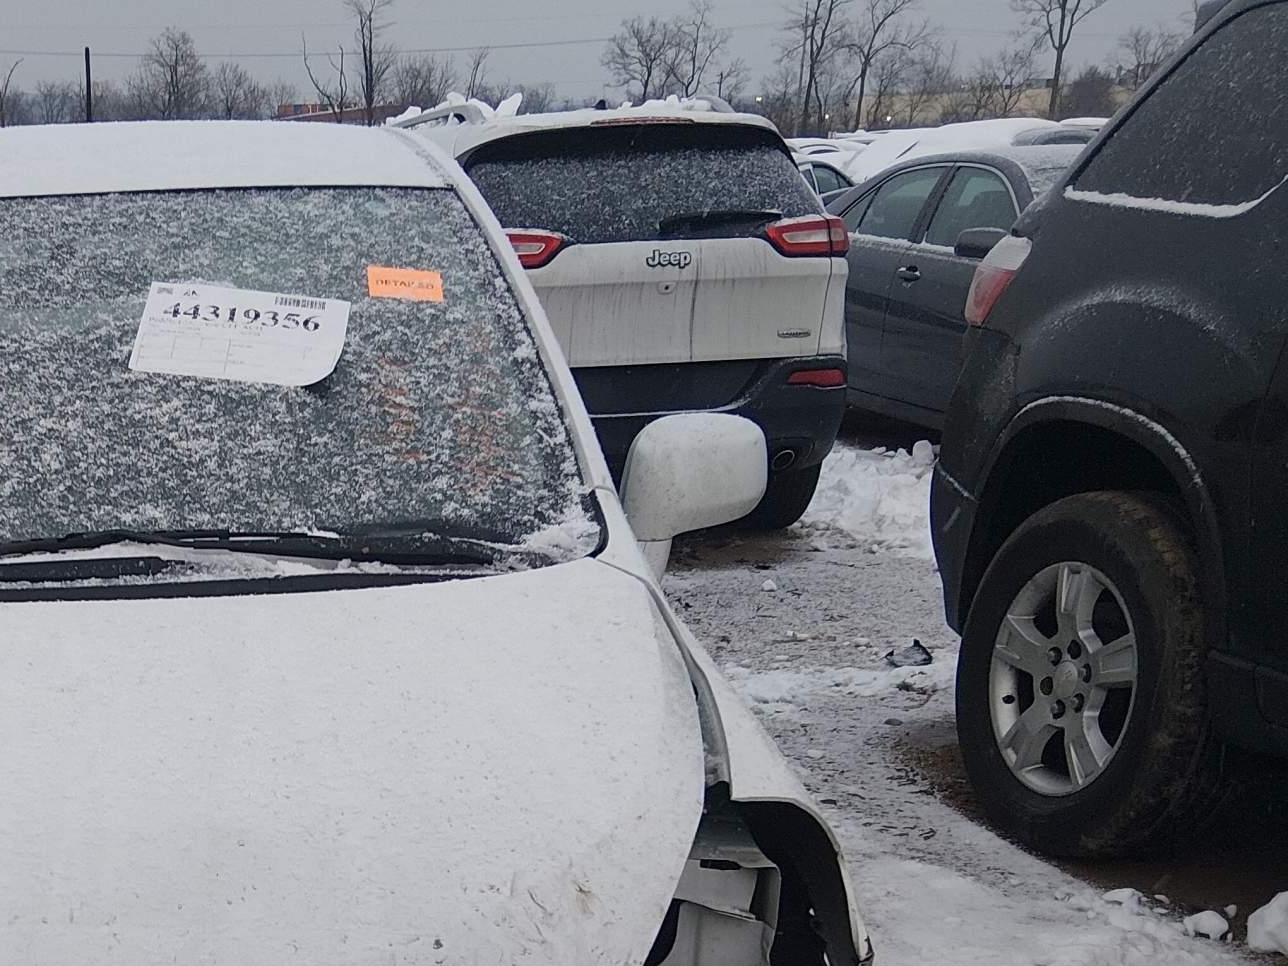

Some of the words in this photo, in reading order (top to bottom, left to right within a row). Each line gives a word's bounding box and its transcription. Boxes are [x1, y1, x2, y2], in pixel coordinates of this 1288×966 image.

[646, 250, 692, 269] Jeep
[374, 278, 435, 290] DETAIED
[162, 302, 321, 333] 44319356
